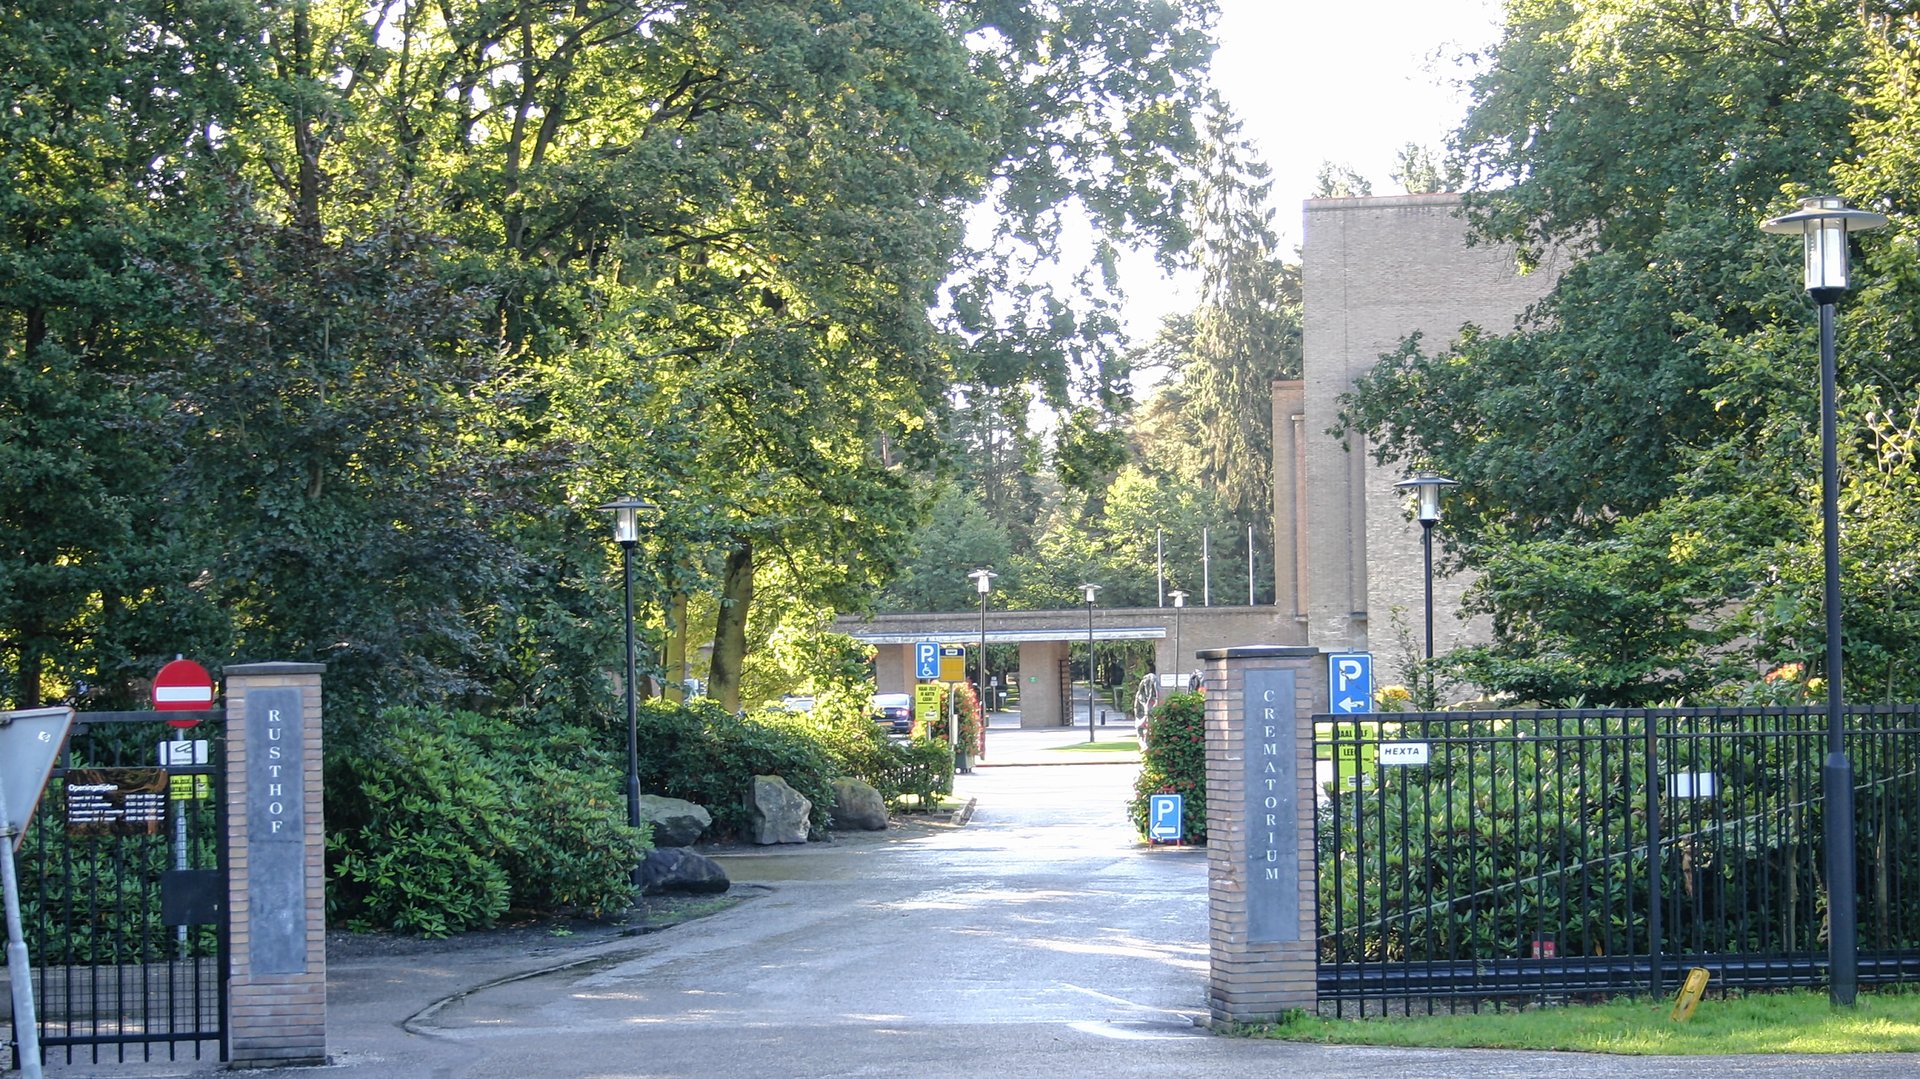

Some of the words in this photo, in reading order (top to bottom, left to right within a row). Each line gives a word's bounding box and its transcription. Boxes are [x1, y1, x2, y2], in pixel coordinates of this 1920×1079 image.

[921, 645, 934, 663] P
[1339, 660, 1362, 692] P
[1384, 747, 1420, 756] HEXTA
[268, 709, 283, 834] RUSTHOF
[1263, 690, 1279, 880] CREMATORIUM
[1158, 800, 1174, 821] P
